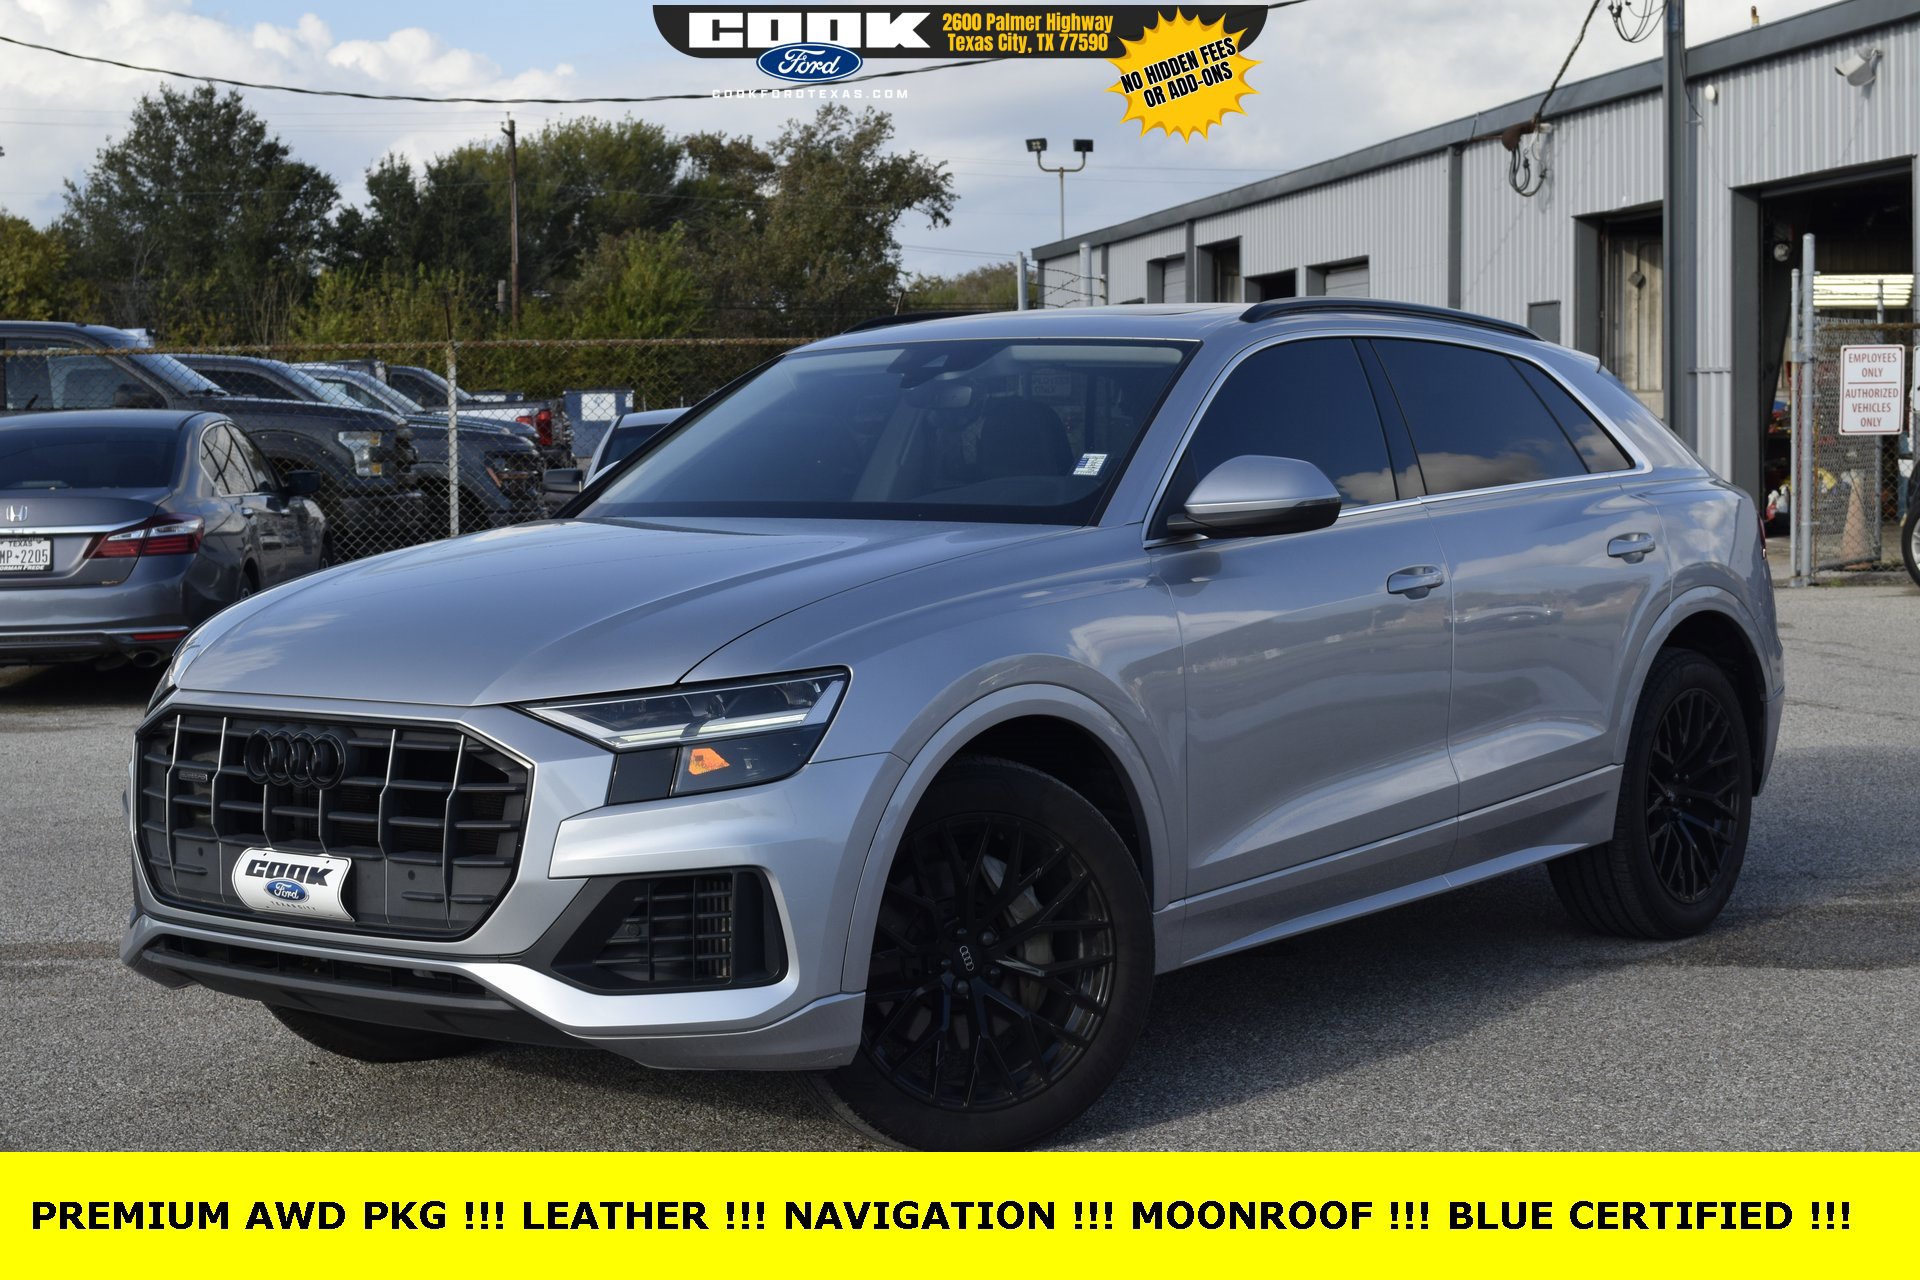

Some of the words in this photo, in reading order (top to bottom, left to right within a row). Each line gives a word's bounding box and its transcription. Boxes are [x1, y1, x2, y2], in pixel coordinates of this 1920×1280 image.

[1848, 353, 1897, 363] EMPLOYEES
[1861, 367, 1883, 377] ONLY
[1845, 388, 1899, 398] AUTHORIZED
[1852, 402, 1891, 413] VEHICLES
[1860, 417, 1882, 427] ONLY
[245, 859, 334, 886] COOK
[274, 882, 299, 899] Ford
